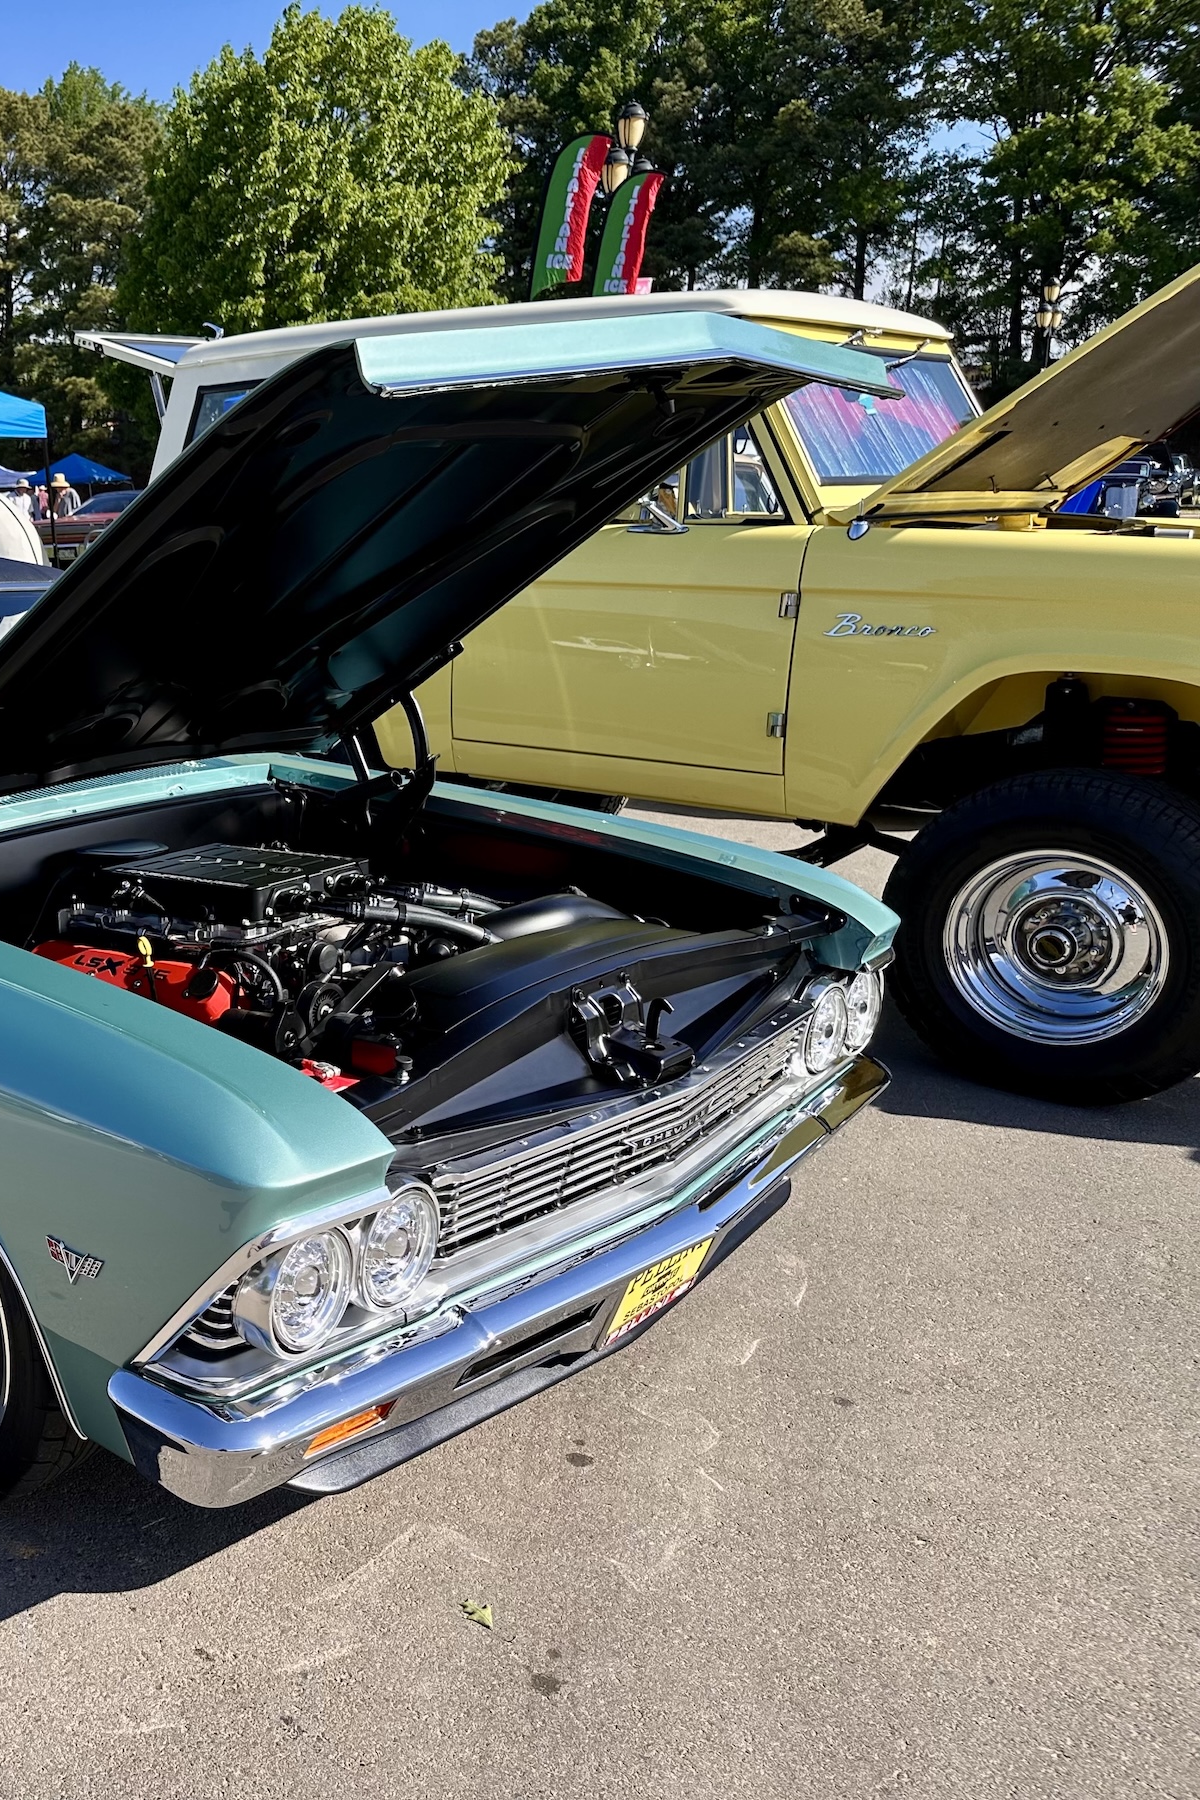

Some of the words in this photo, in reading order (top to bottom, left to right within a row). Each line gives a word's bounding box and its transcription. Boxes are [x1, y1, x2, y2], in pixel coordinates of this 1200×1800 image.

[554, 147, 586, 252] ITALIAN
[611, 185, 641, 278] ITALIAN
[545, 253, 574, 270] ICE
[603, 279, 629, 294] ICE
[823, 613, 937, 637] Bronco
[73, 954, 125, 977] LSX
[623, 1275, 684, 1321] SEBASTOPOL
